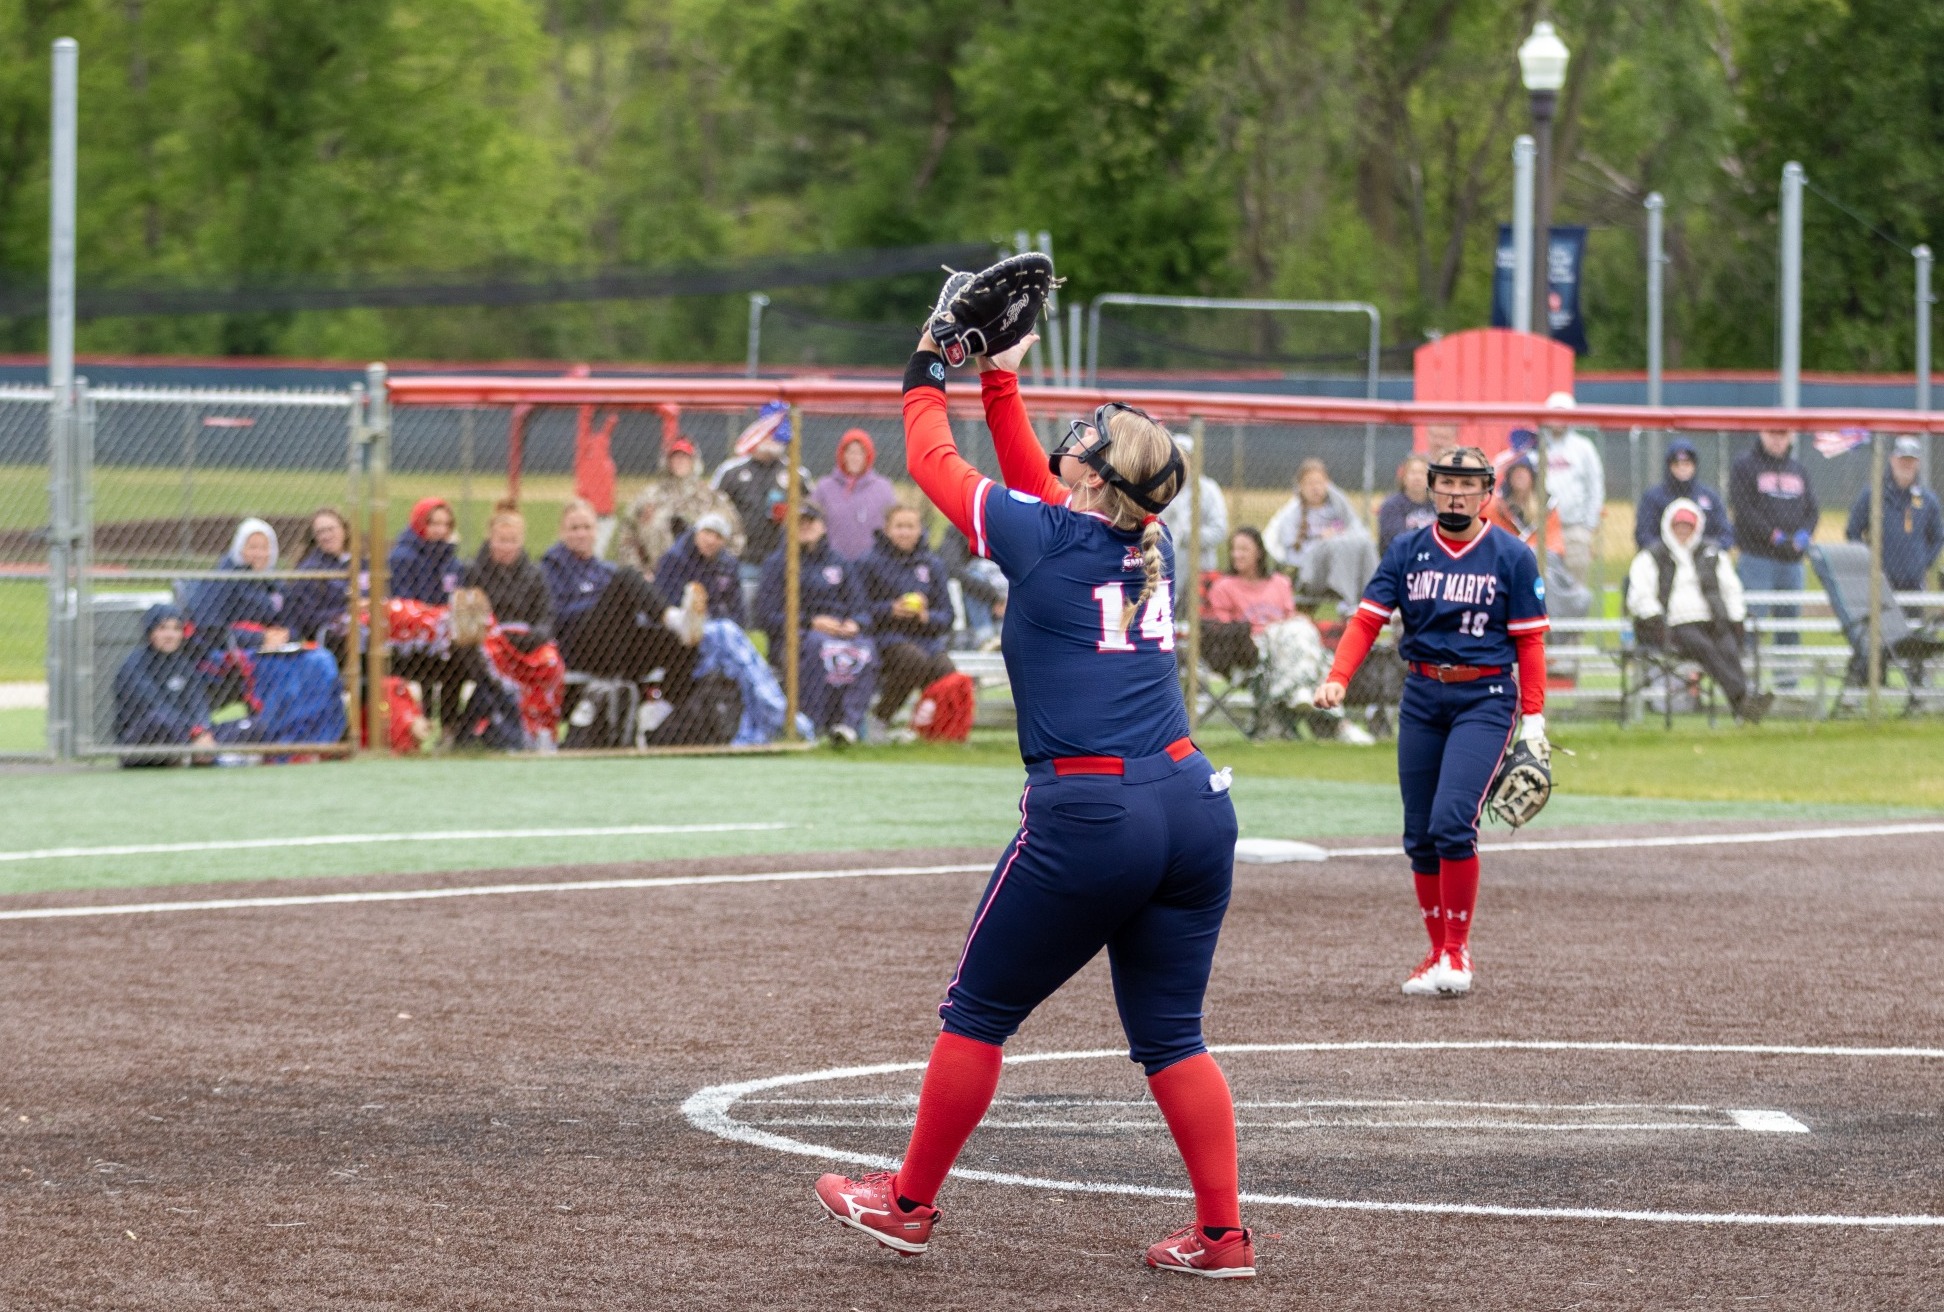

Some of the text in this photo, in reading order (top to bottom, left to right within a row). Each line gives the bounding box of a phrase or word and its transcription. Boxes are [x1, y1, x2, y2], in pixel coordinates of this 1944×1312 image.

[1406, 570, 1497, 606] SAINT MARY'S
[1092, 579, 1175, 653] 14
